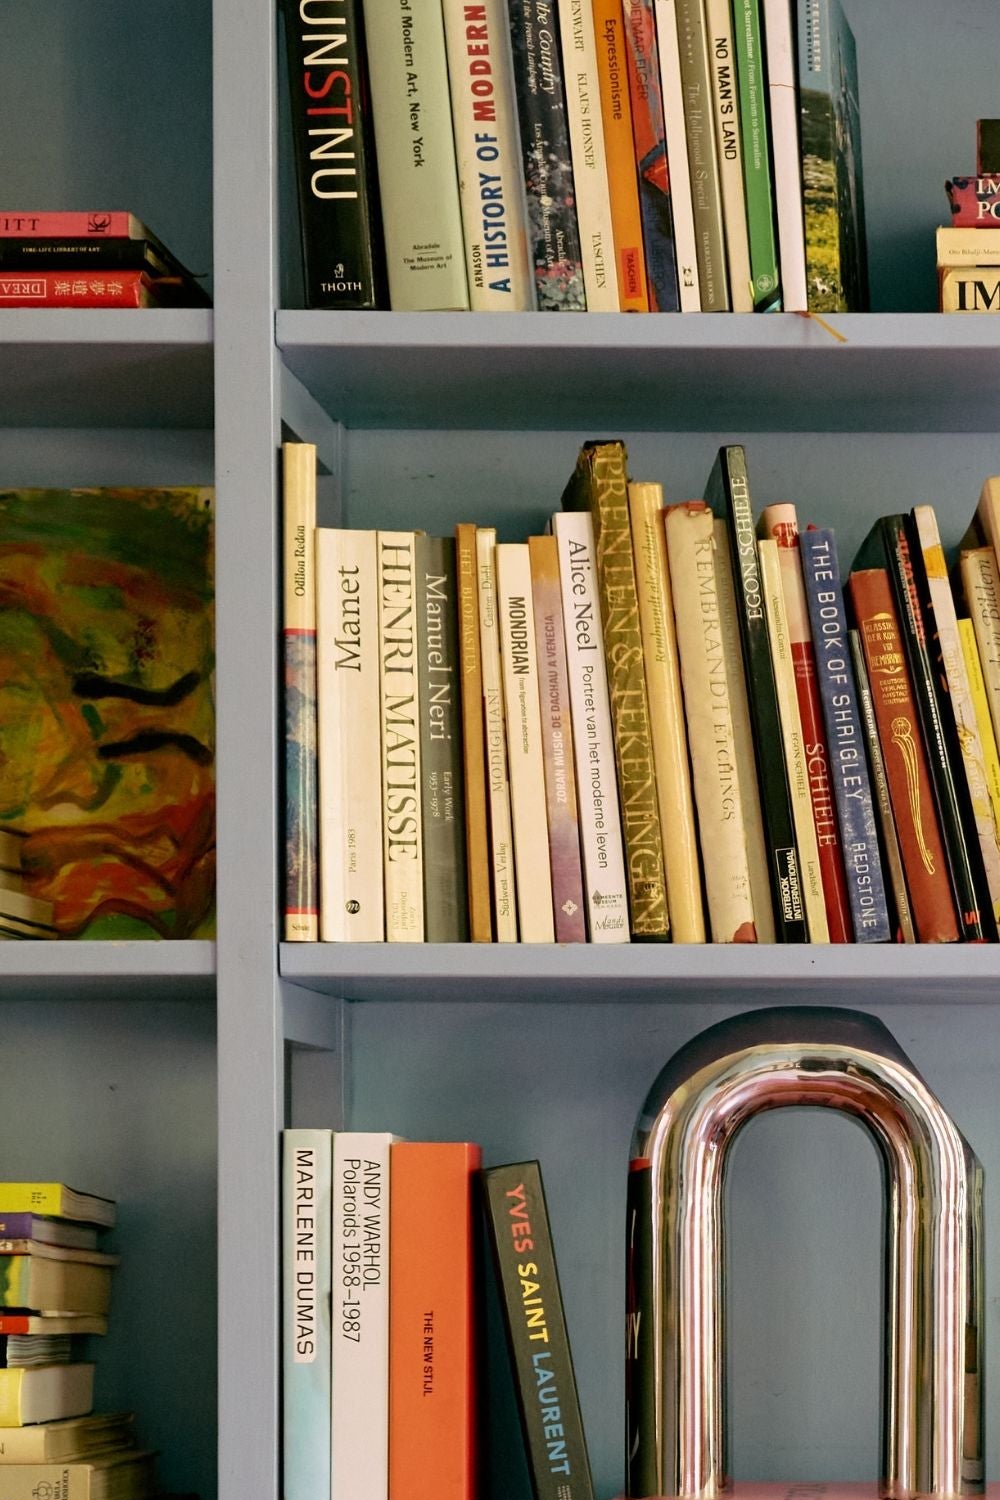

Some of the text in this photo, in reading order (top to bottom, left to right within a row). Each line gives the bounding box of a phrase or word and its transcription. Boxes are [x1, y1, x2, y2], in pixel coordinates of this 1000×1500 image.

[402, 15, 425, 168] Modern New York
[603, 18, 623, 121] Expressionisme
[715, 37, 737, 160] NO MAN'S LAND
[464, 5, 511, 293] A HISTORY OF MODERN
[577, 72, 607, 290] KLAUS TASCHEN
[321, 281, 362, 293] THOTH
[472, 244, 485, 288] ARNASON
[294, 525, 306, 597] Odilon Redon
[382, 541, 414, 675] HENRI
[568, 539, 598, 652] Alice Neel
[731, 476, 763, 621] EGON SCHIELE
[333, 564, 362, 673] Manet
[425, 572, 453, 741] Manuel Neri
[508, 596, 530, 675] MONDRIAN
[694, 540, 736, 822] REMBRANDT ETCHINGS
[487, 687, 505, 793] MODIGLIANI
[544, 615, 568, 804] ZORAN MUSIC DACHAU VENECIA
[582, 665, 609, 869] Portret van het moderne leven
[811, 540, 879, 929] THE BOOK OF SHRIGLEY REDSTONE
[385, 697, 419, 863] MATISSE
[806, 742, 837, 847] SCHIELE
[296, 1150, 315, 1355] MARLENE DUMAS
[342, 1158, 362, 1238] Polaroids
[362, 1159, 381, 1291] ANDY WARHOL
[422, 1310, 434, 1397] THE NEW STIJL
[506, 1183, 572, 1476] YVES SAINT LAURENT
